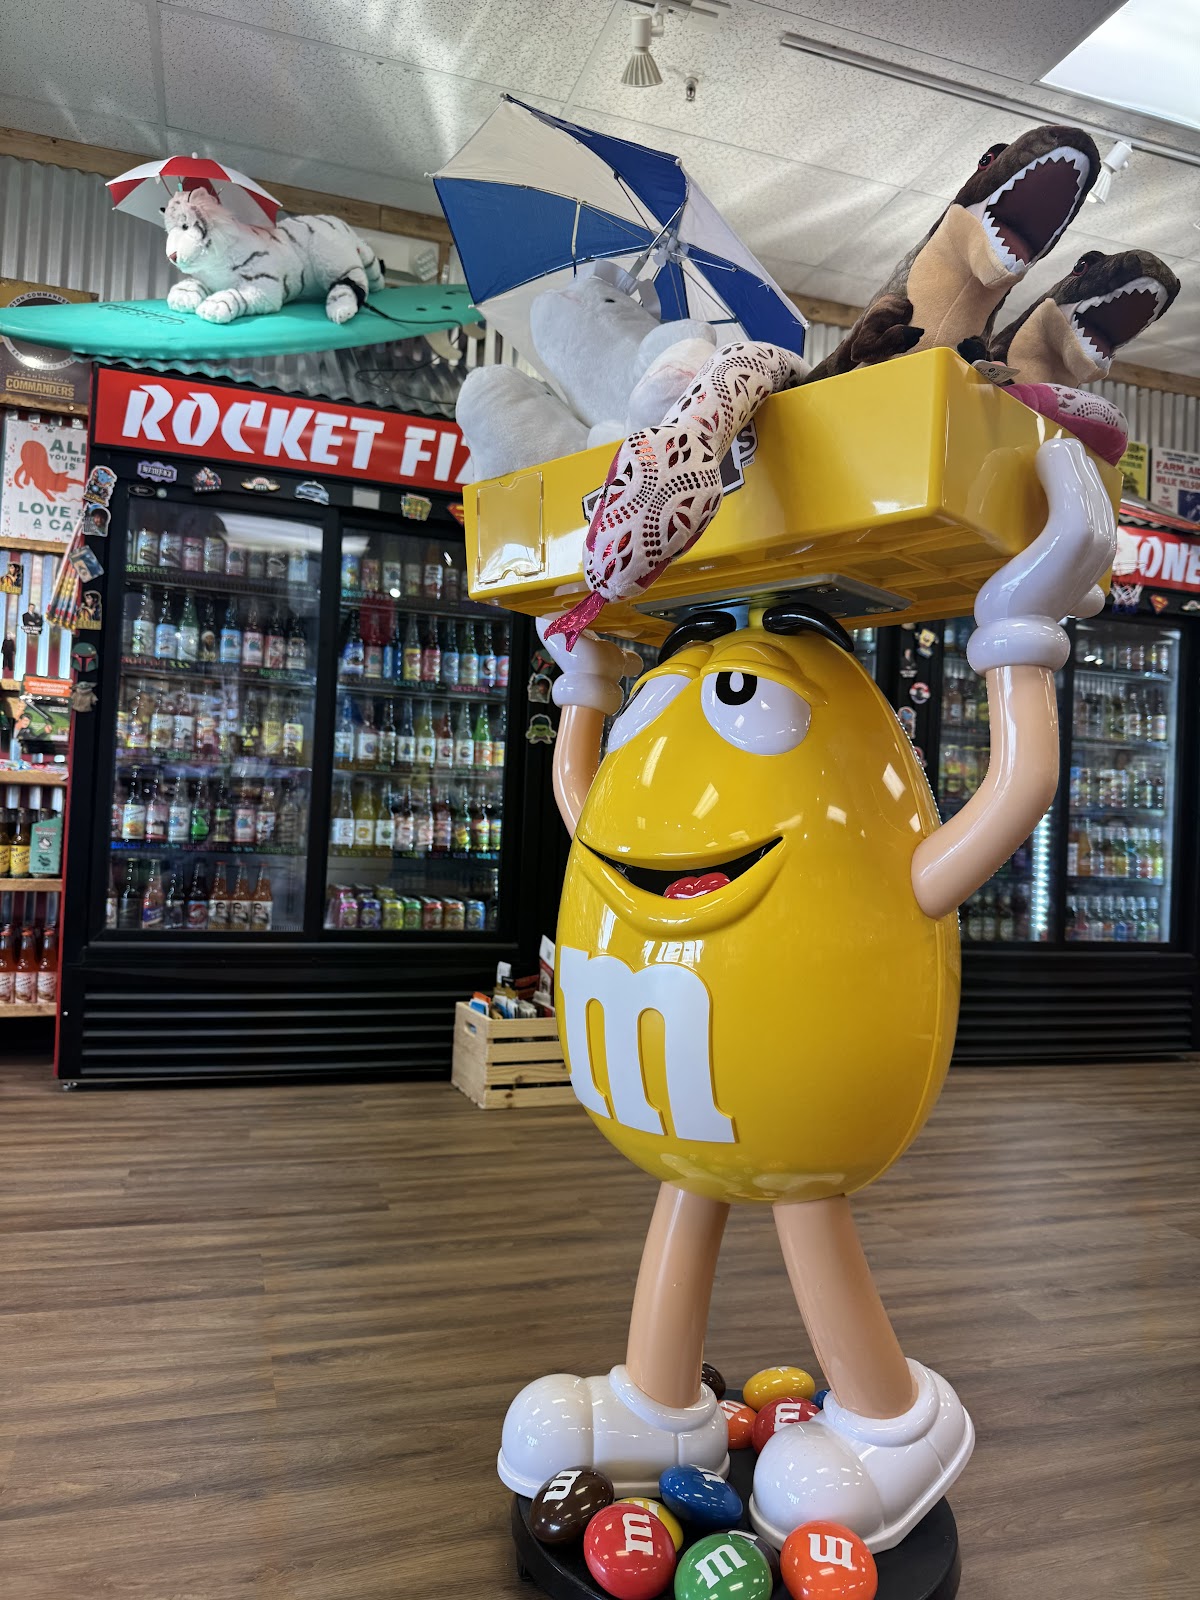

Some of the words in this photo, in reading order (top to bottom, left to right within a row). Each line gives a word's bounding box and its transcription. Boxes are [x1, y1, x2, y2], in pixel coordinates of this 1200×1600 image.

[27, 291, 70, 304] COMMANDE
[6, 378, 75, 396] COMMANDERS
[122, 384, 385, 470] ROCKET
[399, 424, 473, 485] FIZ
[50, 453, 68, 462] YOU
[70, 455, 86, 464] NEE
[65, 462, 76, 471] IS
[1156, 461, 1185, 473] FARM
[1156, 475, 1178, 487] WILLIE
[1179, 479, 1200, 490] NELSO
[18, 501, 71, 518] LOVE
[33, 518, 42, 527] A
[49, 519, 75, 532] CA
[1138, 535, 1200, 584] ONE
[694, 1544, 748, 1590] m
